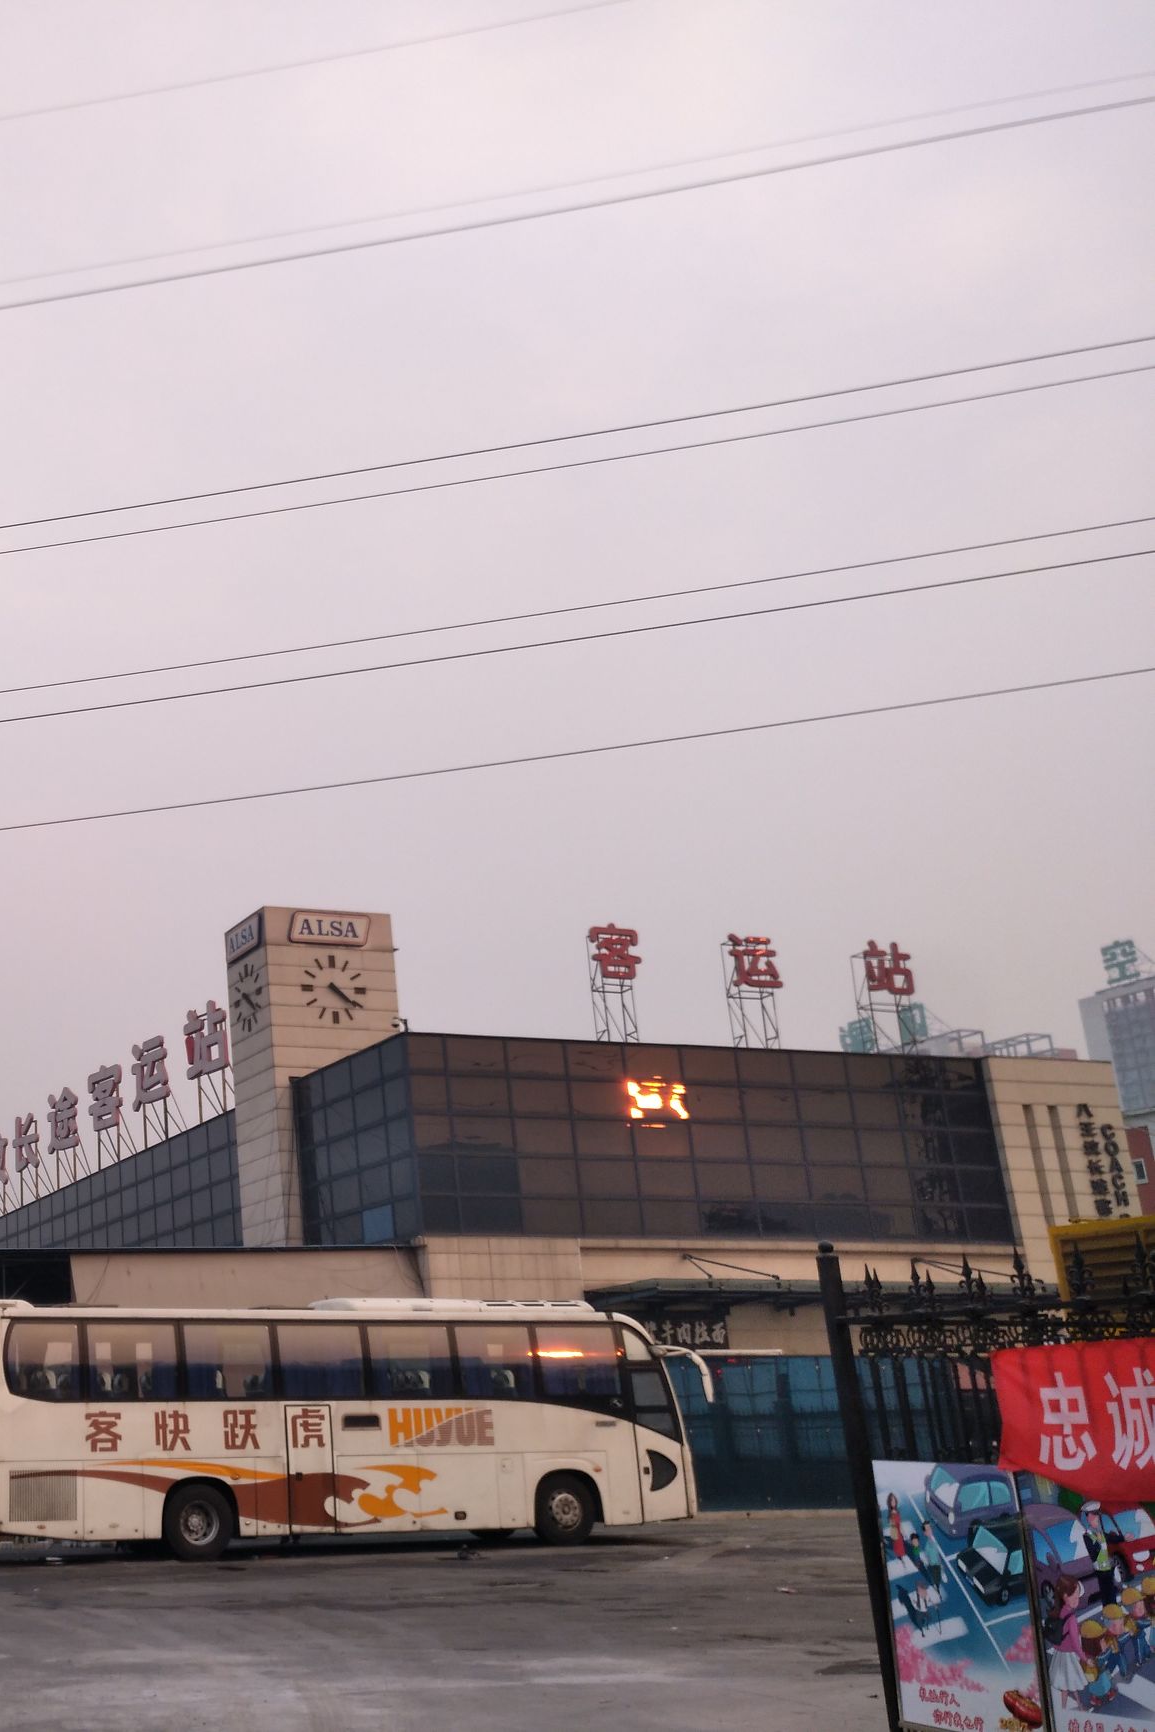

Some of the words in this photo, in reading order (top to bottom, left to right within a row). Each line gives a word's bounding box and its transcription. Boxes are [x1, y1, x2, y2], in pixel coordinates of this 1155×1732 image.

[229, 924, 254, 955] ALSA
[298, 919, 359, 938] ALSA
[587, 923, 915, 997] 客运站
[388, 1407, 494, 1447] HUYUE
[1039, 1366, 1155, 1471] 忠诚
